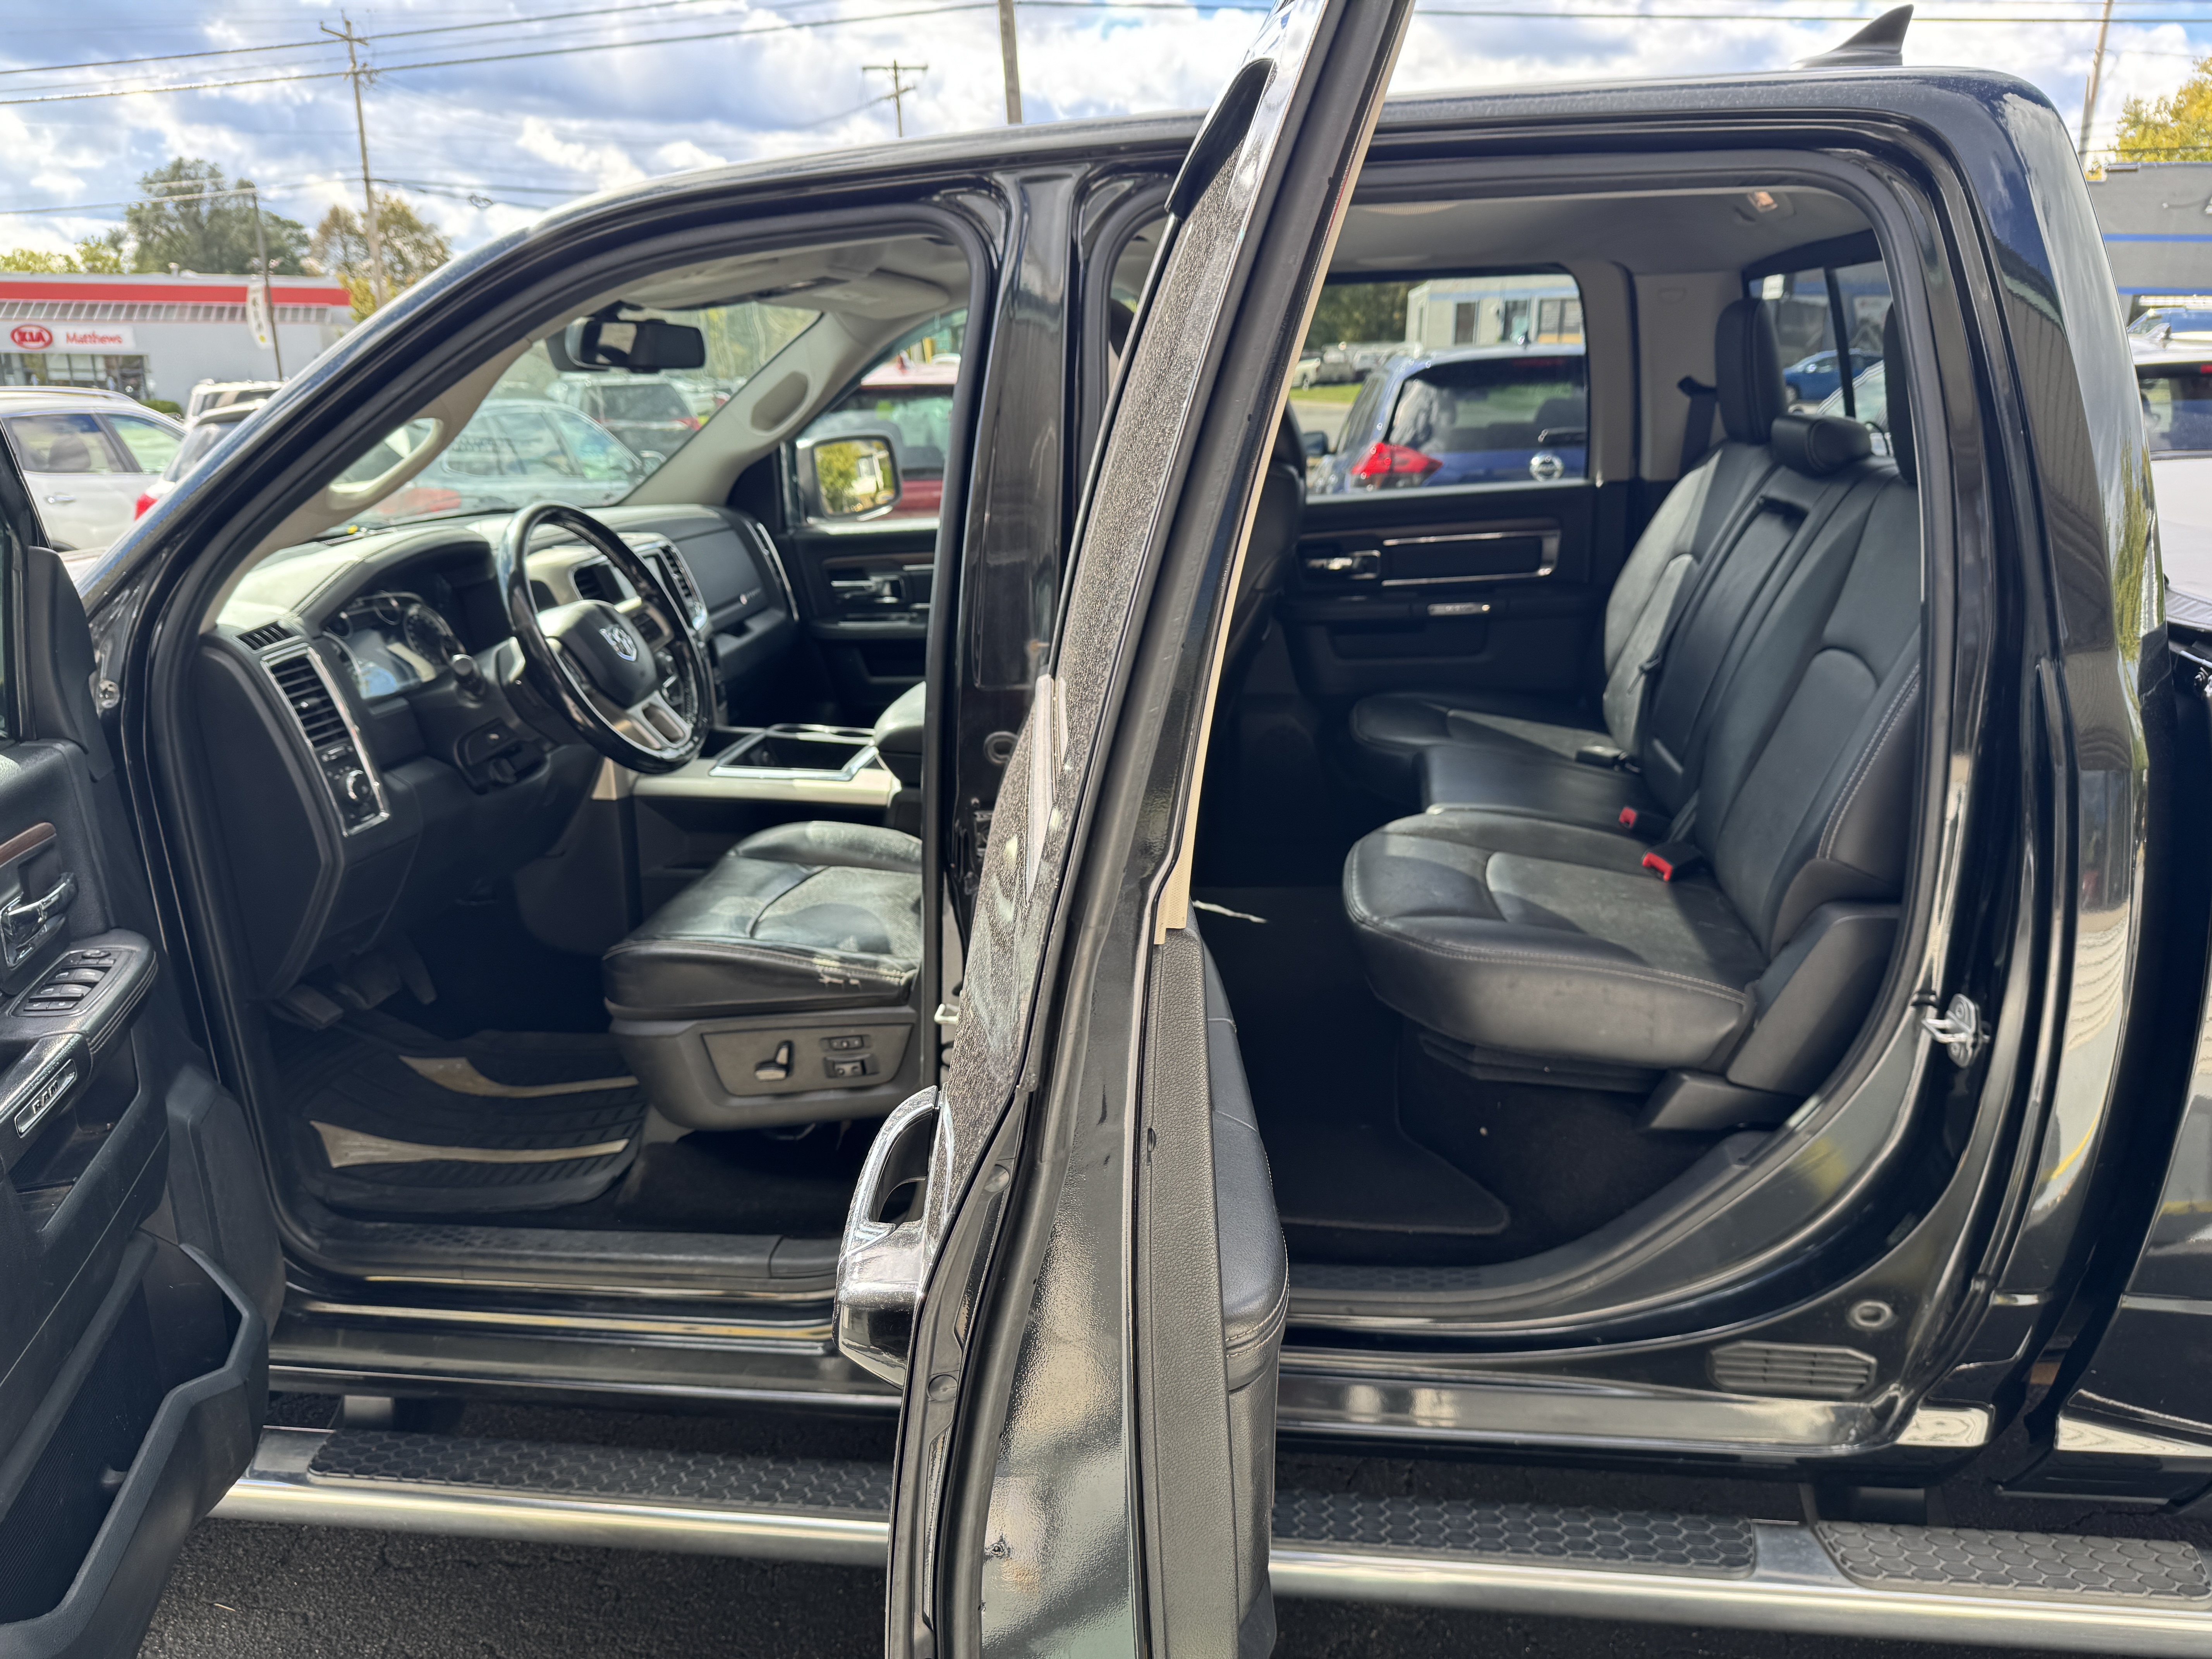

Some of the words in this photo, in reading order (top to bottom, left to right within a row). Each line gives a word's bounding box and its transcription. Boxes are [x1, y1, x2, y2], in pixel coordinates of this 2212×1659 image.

[18, 331, 46, 342] KIA
[66, 330, 123, 344] Matthews
[32, 1080, 58, 1114] RAM
